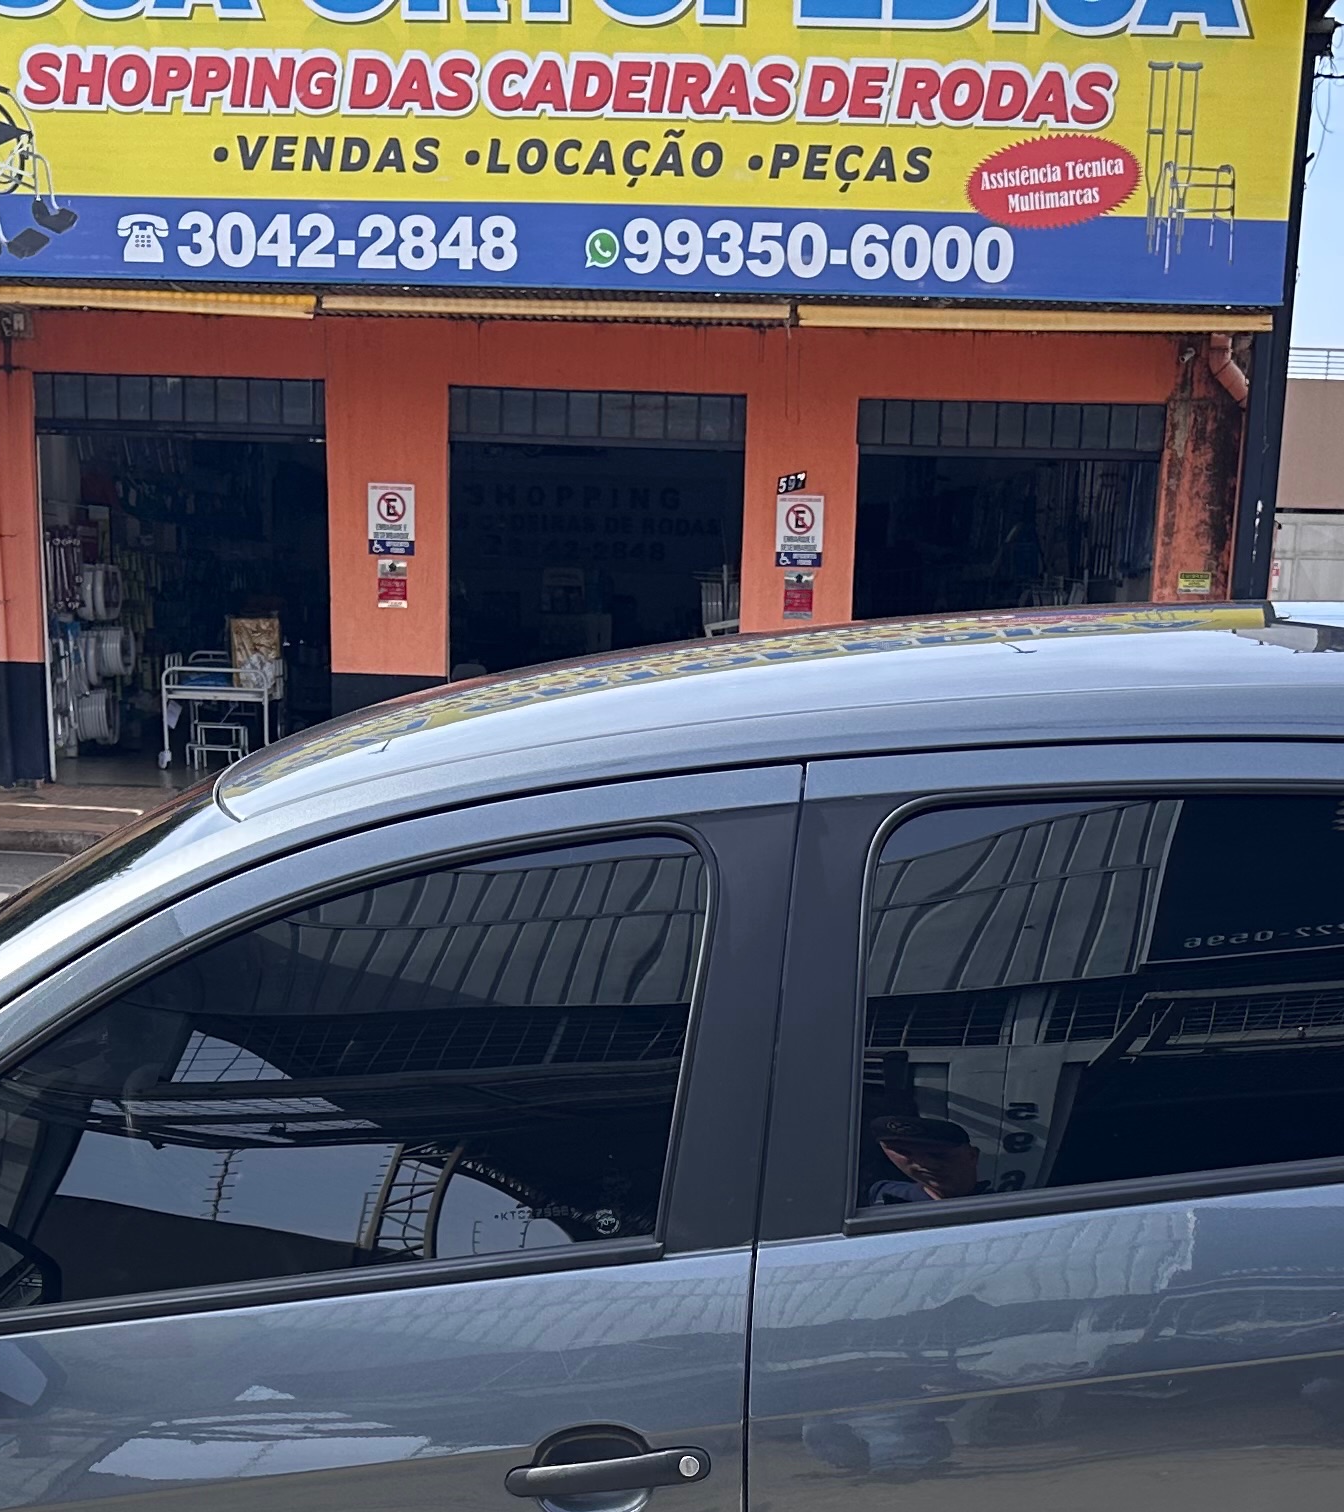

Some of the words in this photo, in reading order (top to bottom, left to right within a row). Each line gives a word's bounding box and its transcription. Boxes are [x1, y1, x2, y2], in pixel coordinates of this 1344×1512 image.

[23, 52, 337, 109] SHOPPING
[349, 58, 474, 111] DAS
[488, 59, 793, 116] CADEIRAS
[805, 65, 889, 118] DE
[897, 67, 1112, 124] RODAS
[980, 165, 1062, 191] Assistência
[1065, 157, 1124, 181] Técnica
[1007, 186, 1100, 213] Multimarcas
[177, 211, 518, 272] 3042-2848
[623, 217, 1014, 283] 99350-6000
